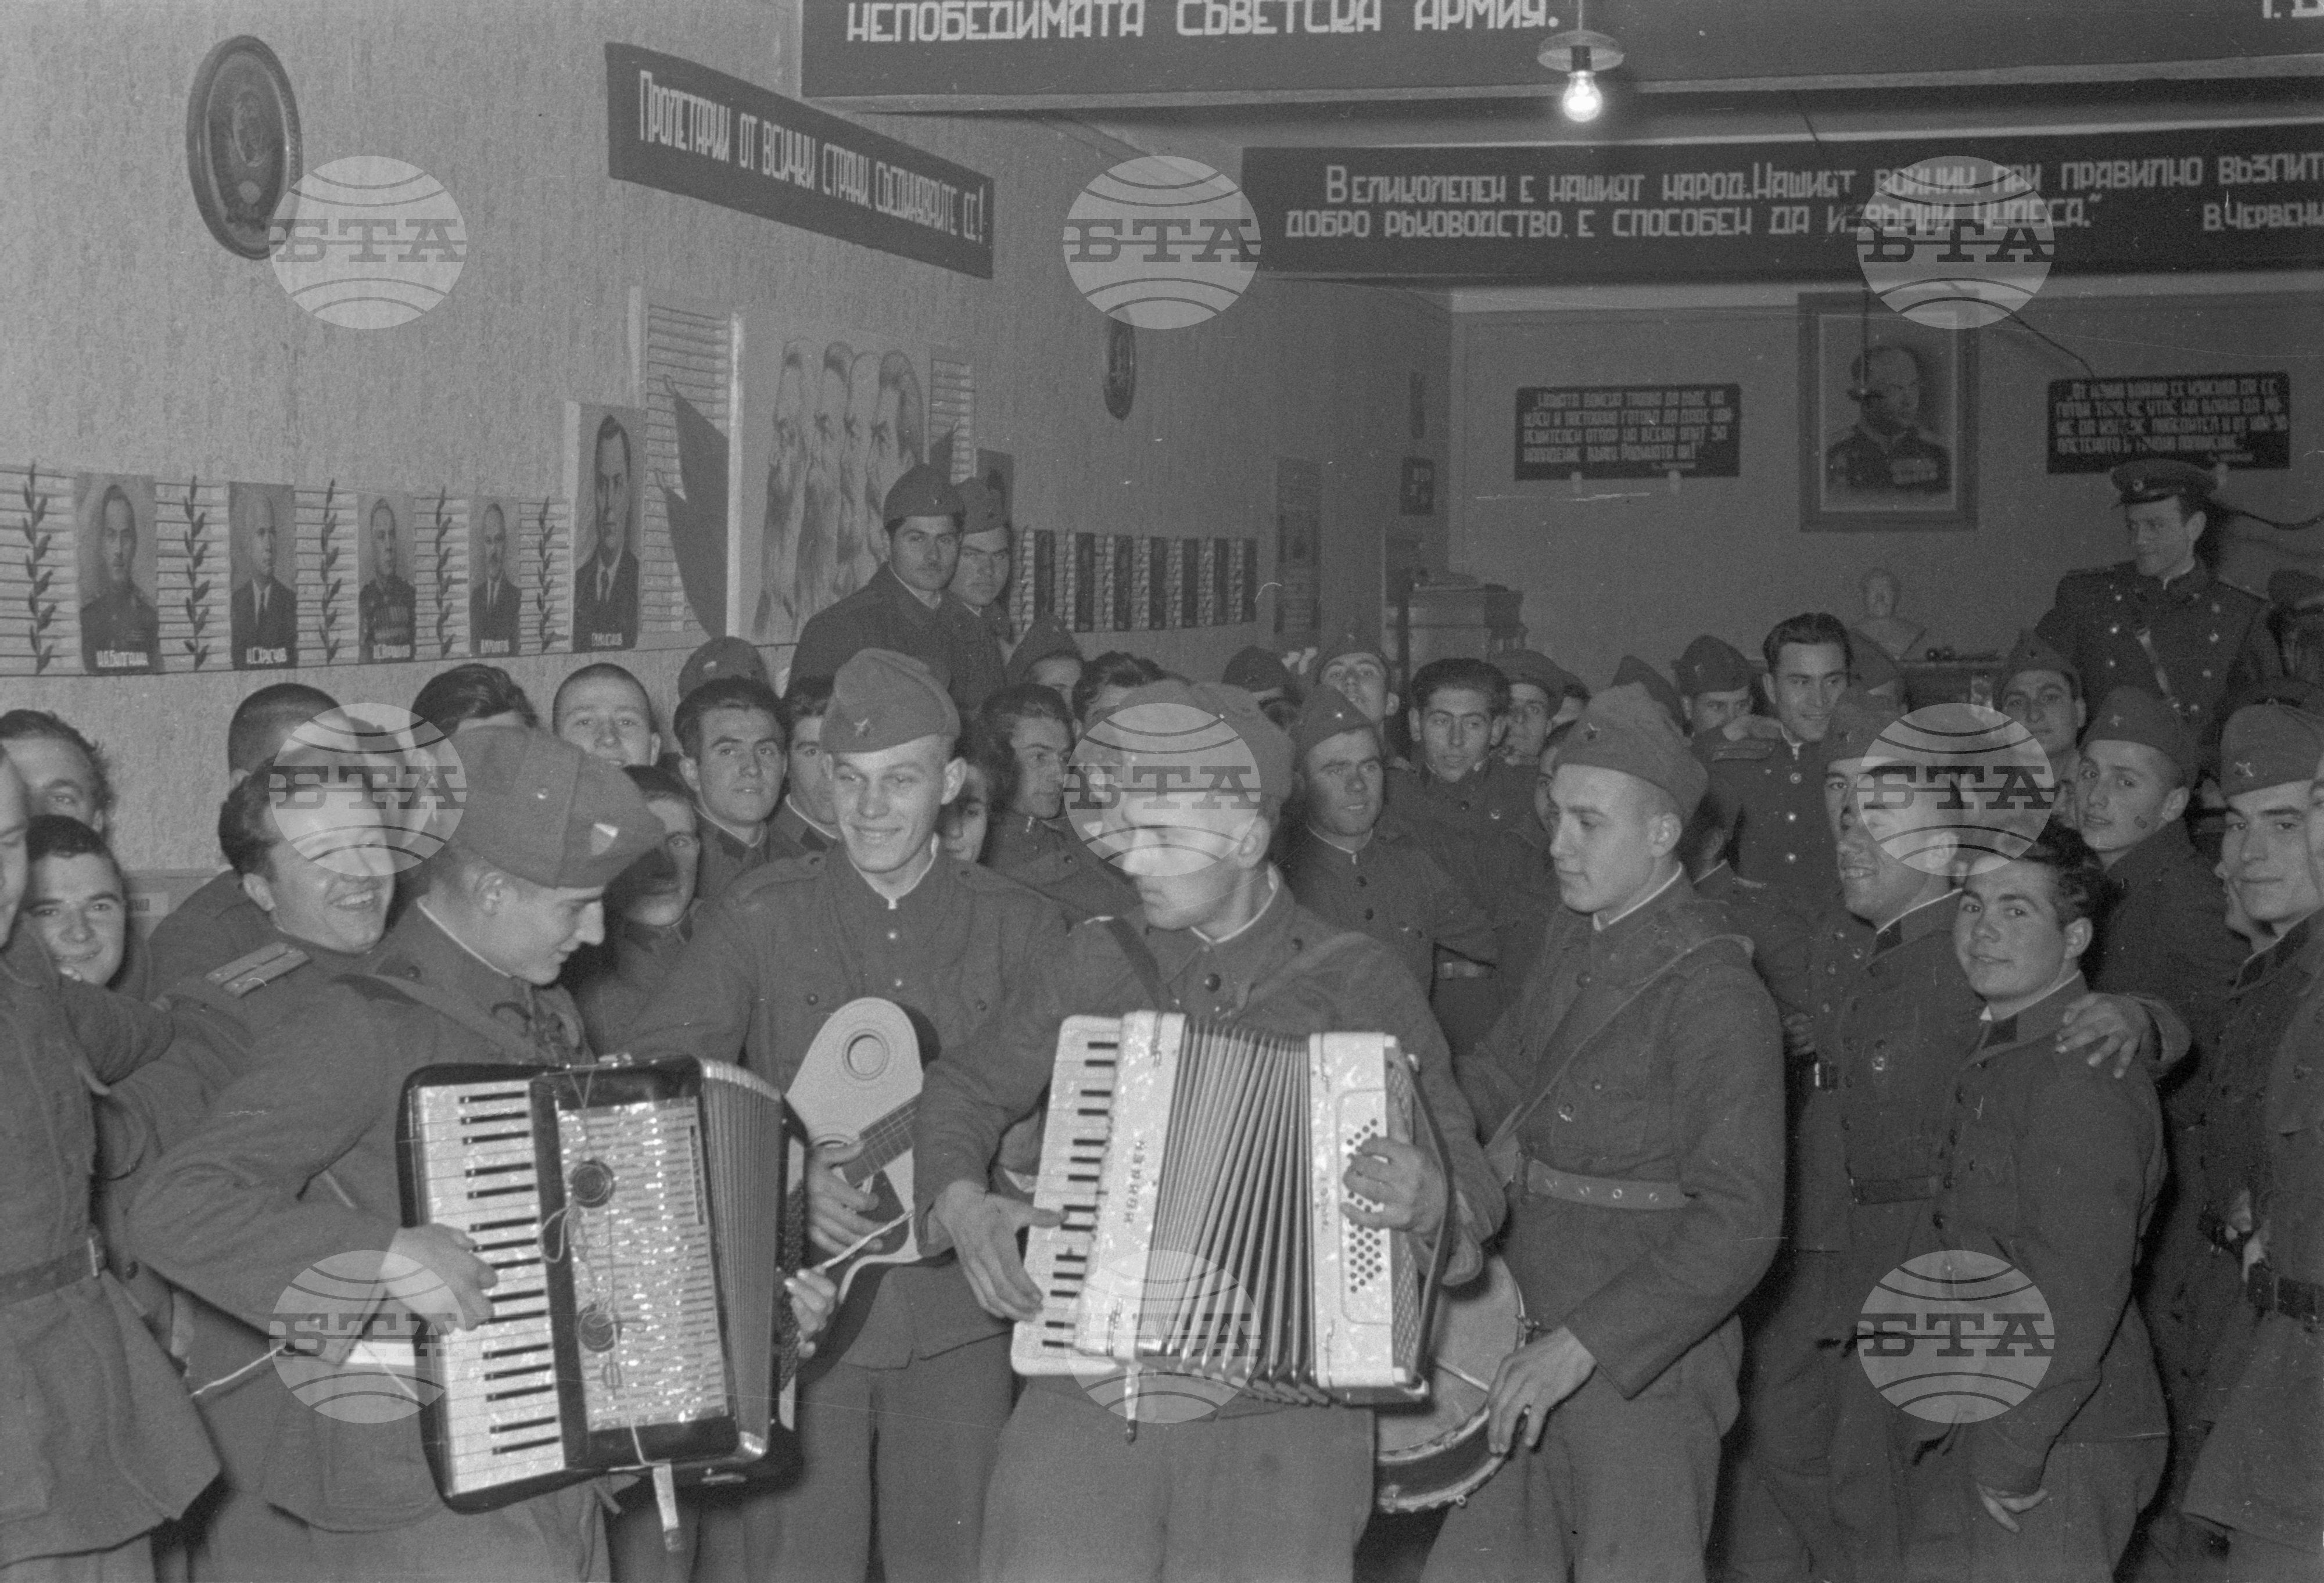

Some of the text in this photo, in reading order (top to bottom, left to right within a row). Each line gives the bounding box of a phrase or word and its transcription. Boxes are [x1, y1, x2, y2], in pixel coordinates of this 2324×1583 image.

[847, 0, 1145, 42] НЕПОБЕДИМАТА
[739, 113, 758, 170] ОТ
[1548, 174, 1646, 202] НАШИЯТ
[2061, 156, 2204, 191] ПРАВИЛНО
[1285, 210, 1371, 238] ДОБРО
[1612, 206, 1753, 237] СПОСОБЕН
[1768, 205, 1810, 234] ДА
